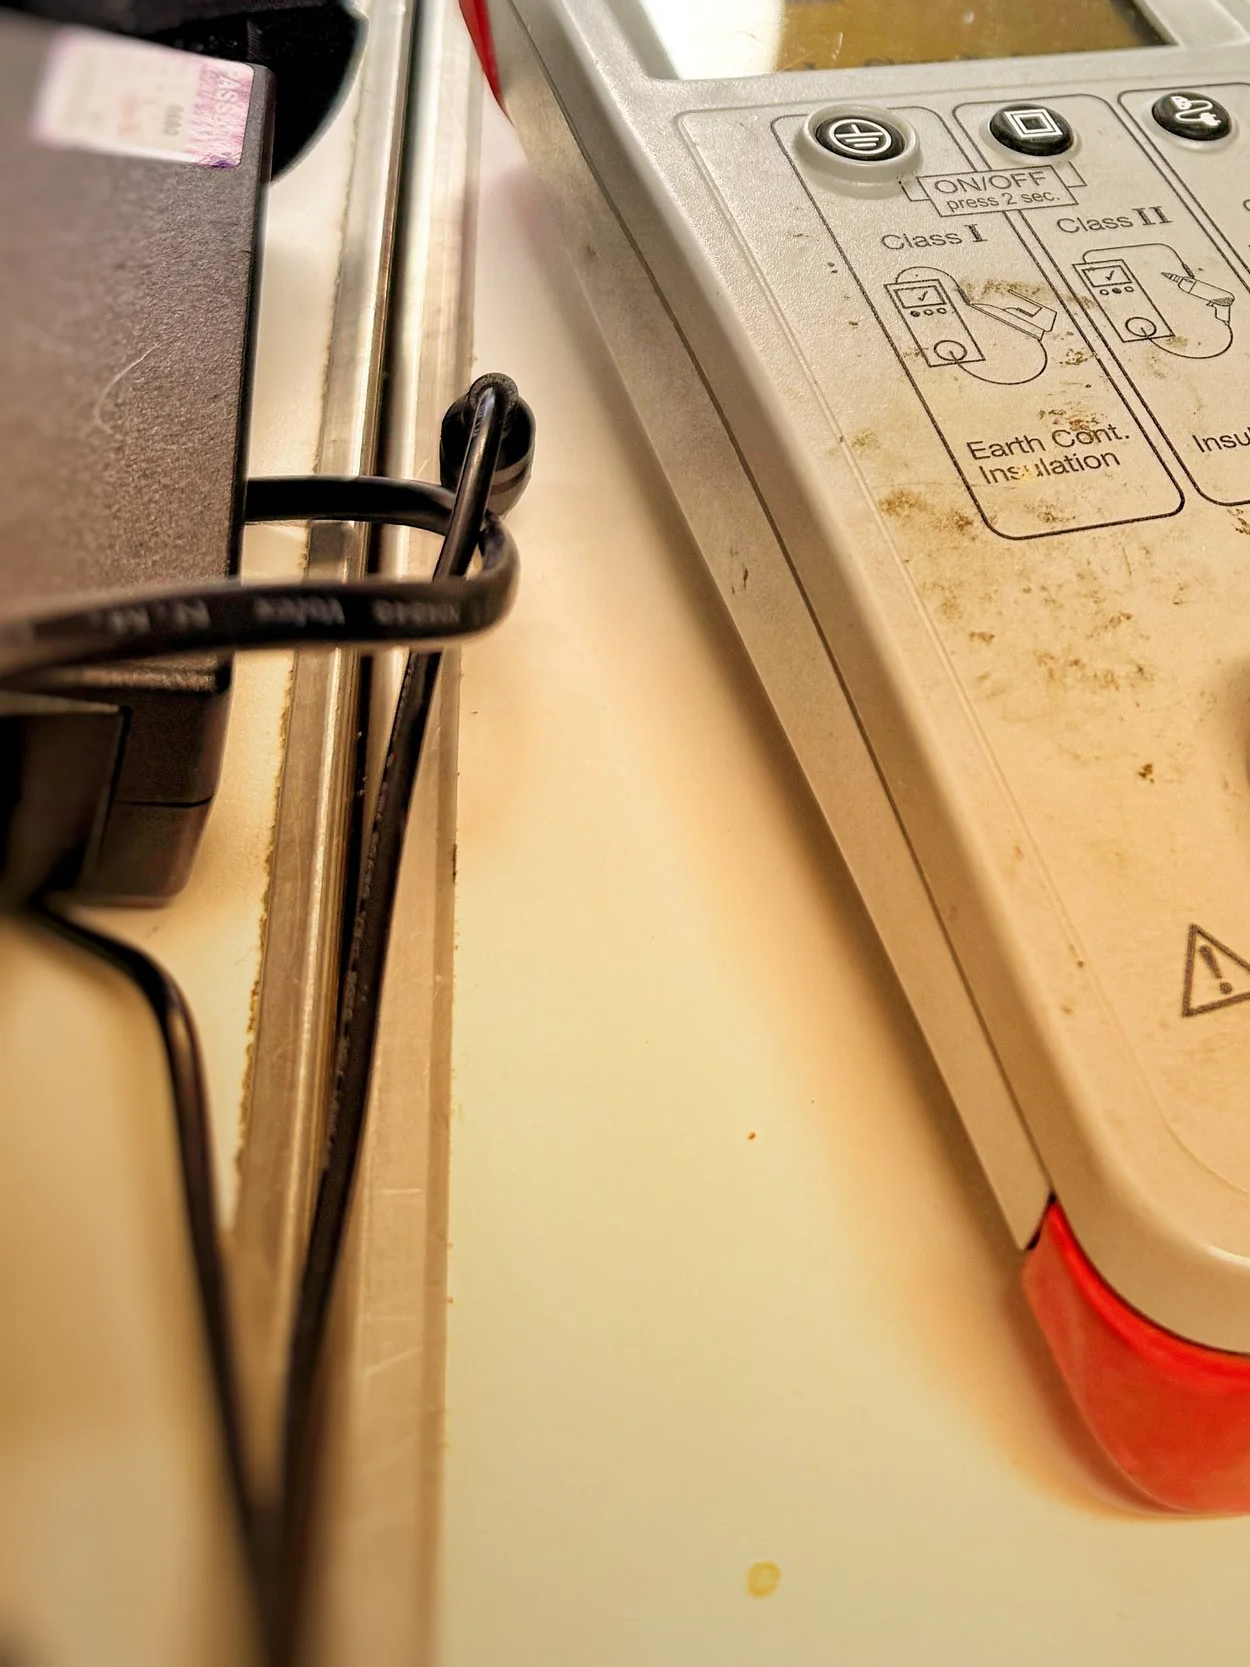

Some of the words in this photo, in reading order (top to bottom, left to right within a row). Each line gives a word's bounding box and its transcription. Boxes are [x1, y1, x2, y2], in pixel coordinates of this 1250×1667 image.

[934, 171, 1047, 194] ON/OFF
[945, 194, 999, 212] press
[1005, 192, 1017, 205] 2
[1022, 190, 1061, 203] sec.
[1056, 214, 1134, 234] Class
[1132, 206, 1173, 225] II
[881, 231, 963, 251] Class
[967, 435, 1046, 460] Earth
[1052, 423, 1130, 448] Cont.
